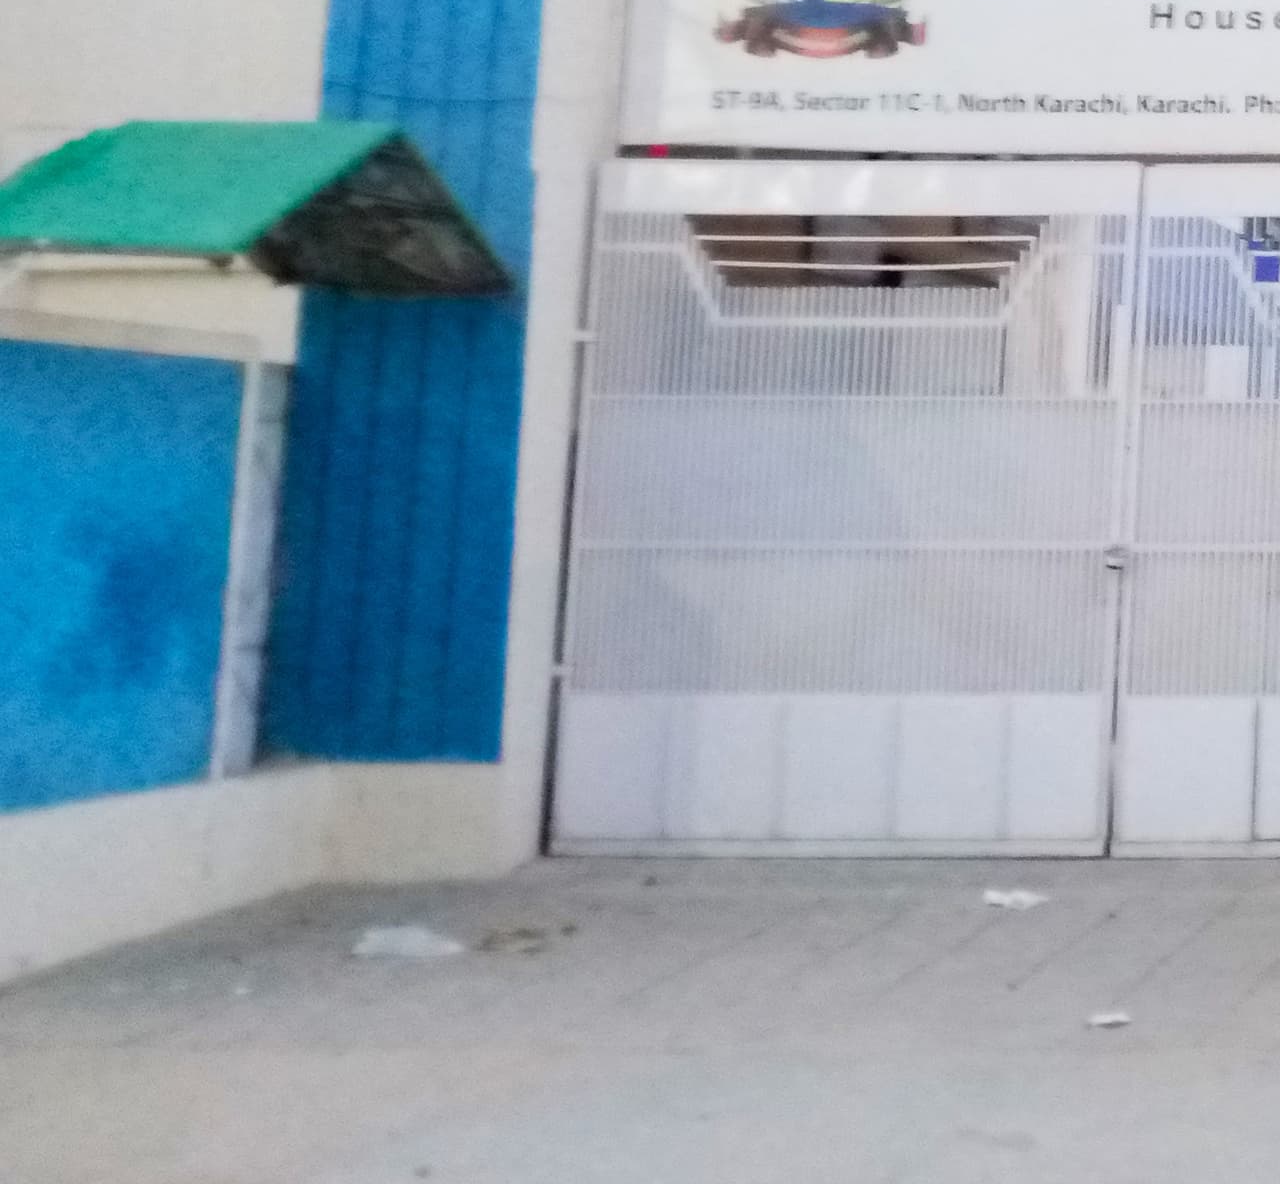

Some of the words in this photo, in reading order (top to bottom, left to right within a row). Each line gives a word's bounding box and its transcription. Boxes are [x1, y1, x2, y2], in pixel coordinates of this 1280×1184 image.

[793, 91, 870, 111] Sector
[957, 93, 1027, 113] North
[1034, 93, 1129, 115] Karachi,
